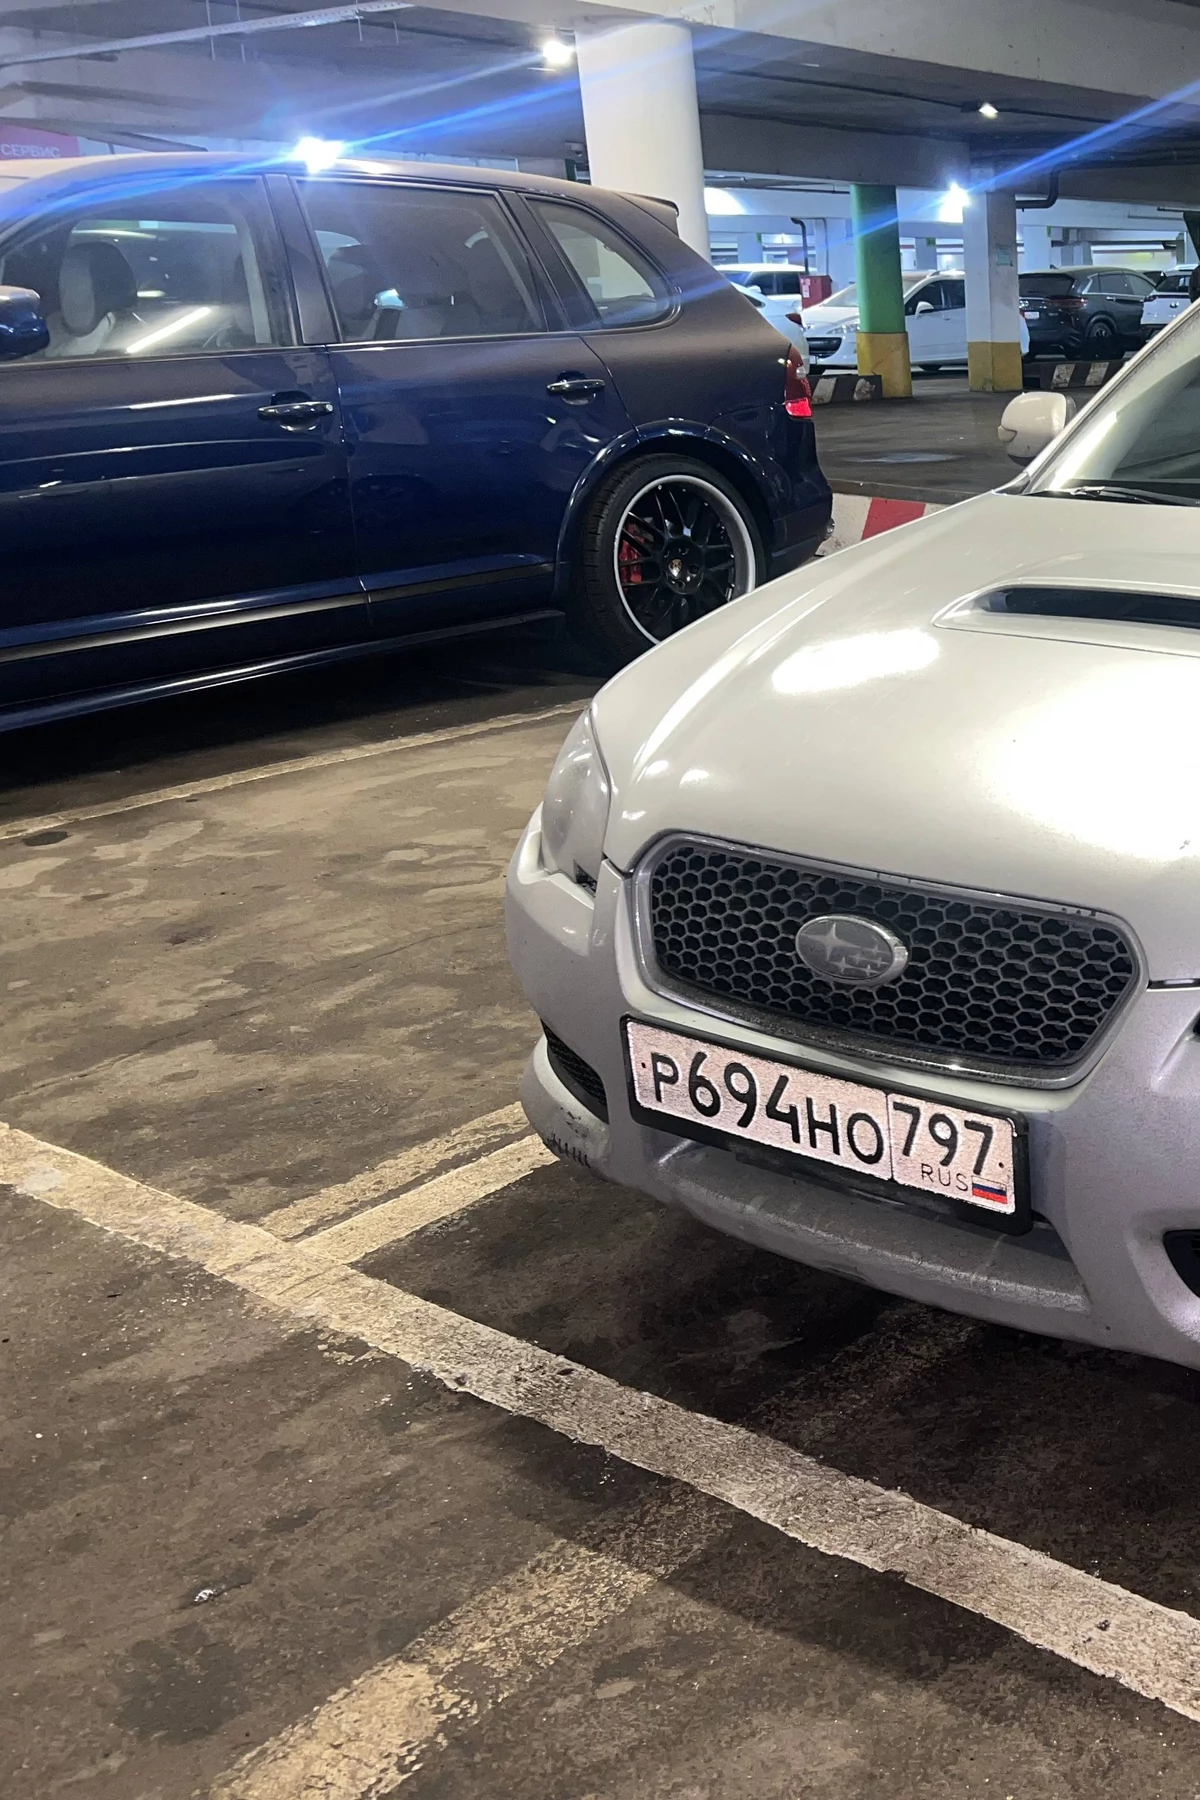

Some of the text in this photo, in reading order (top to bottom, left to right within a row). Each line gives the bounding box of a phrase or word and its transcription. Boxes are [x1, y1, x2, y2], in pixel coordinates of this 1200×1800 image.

[1, 143, 61, 158] СЕРВИС
[893, 1101, 994, 1175] 797
[920, 1162, 969, 1192] RUS
